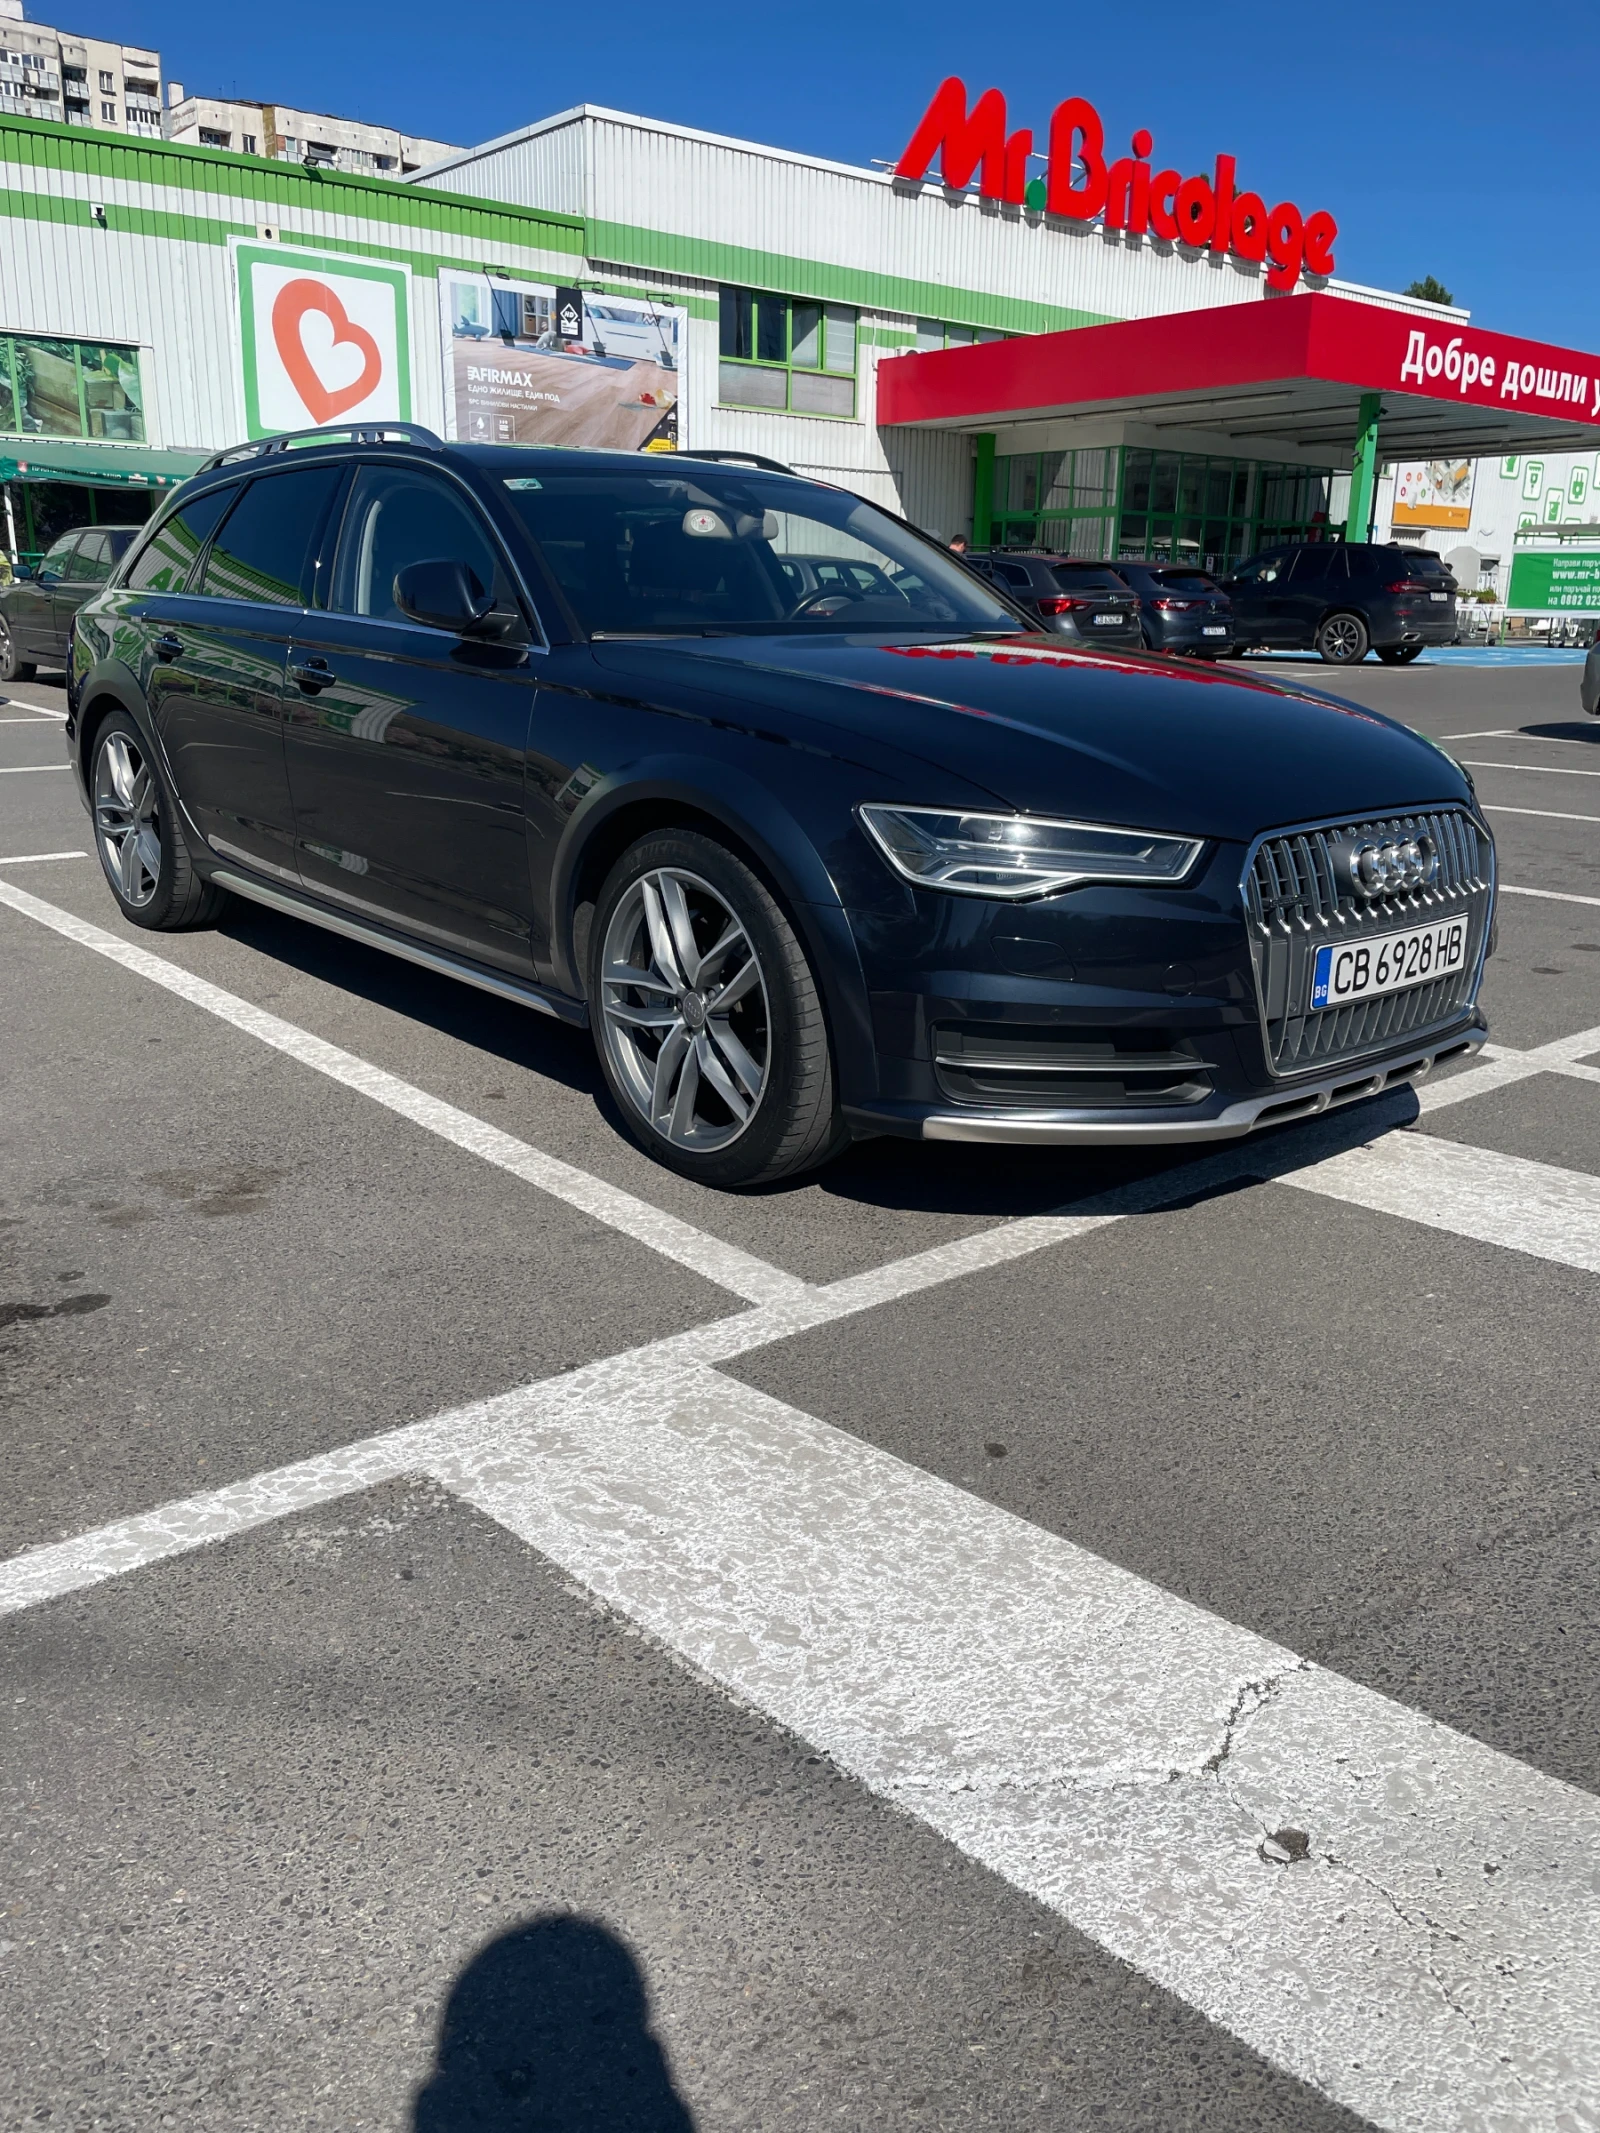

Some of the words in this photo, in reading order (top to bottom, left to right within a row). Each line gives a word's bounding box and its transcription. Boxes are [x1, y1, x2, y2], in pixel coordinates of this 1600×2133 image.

[467, 366, 533, 387] AFIRMAX
[1400, 330, 1495, 394] Добре
[1500, 361, 1587, 405] дошли
[467, 384, 488, 395] ЕДНО
[544, 393, 560, 403] ПОД
[1553, 558, 1581, 569] Направи
[1547, 597, 1558, 606] на
[1334, 948, 1370, 994] CB
[1375, 933, 1432, 985] 6928
[1434, 924, 1462, 970] HB
[1314, 985, 1328, 1000] BG
